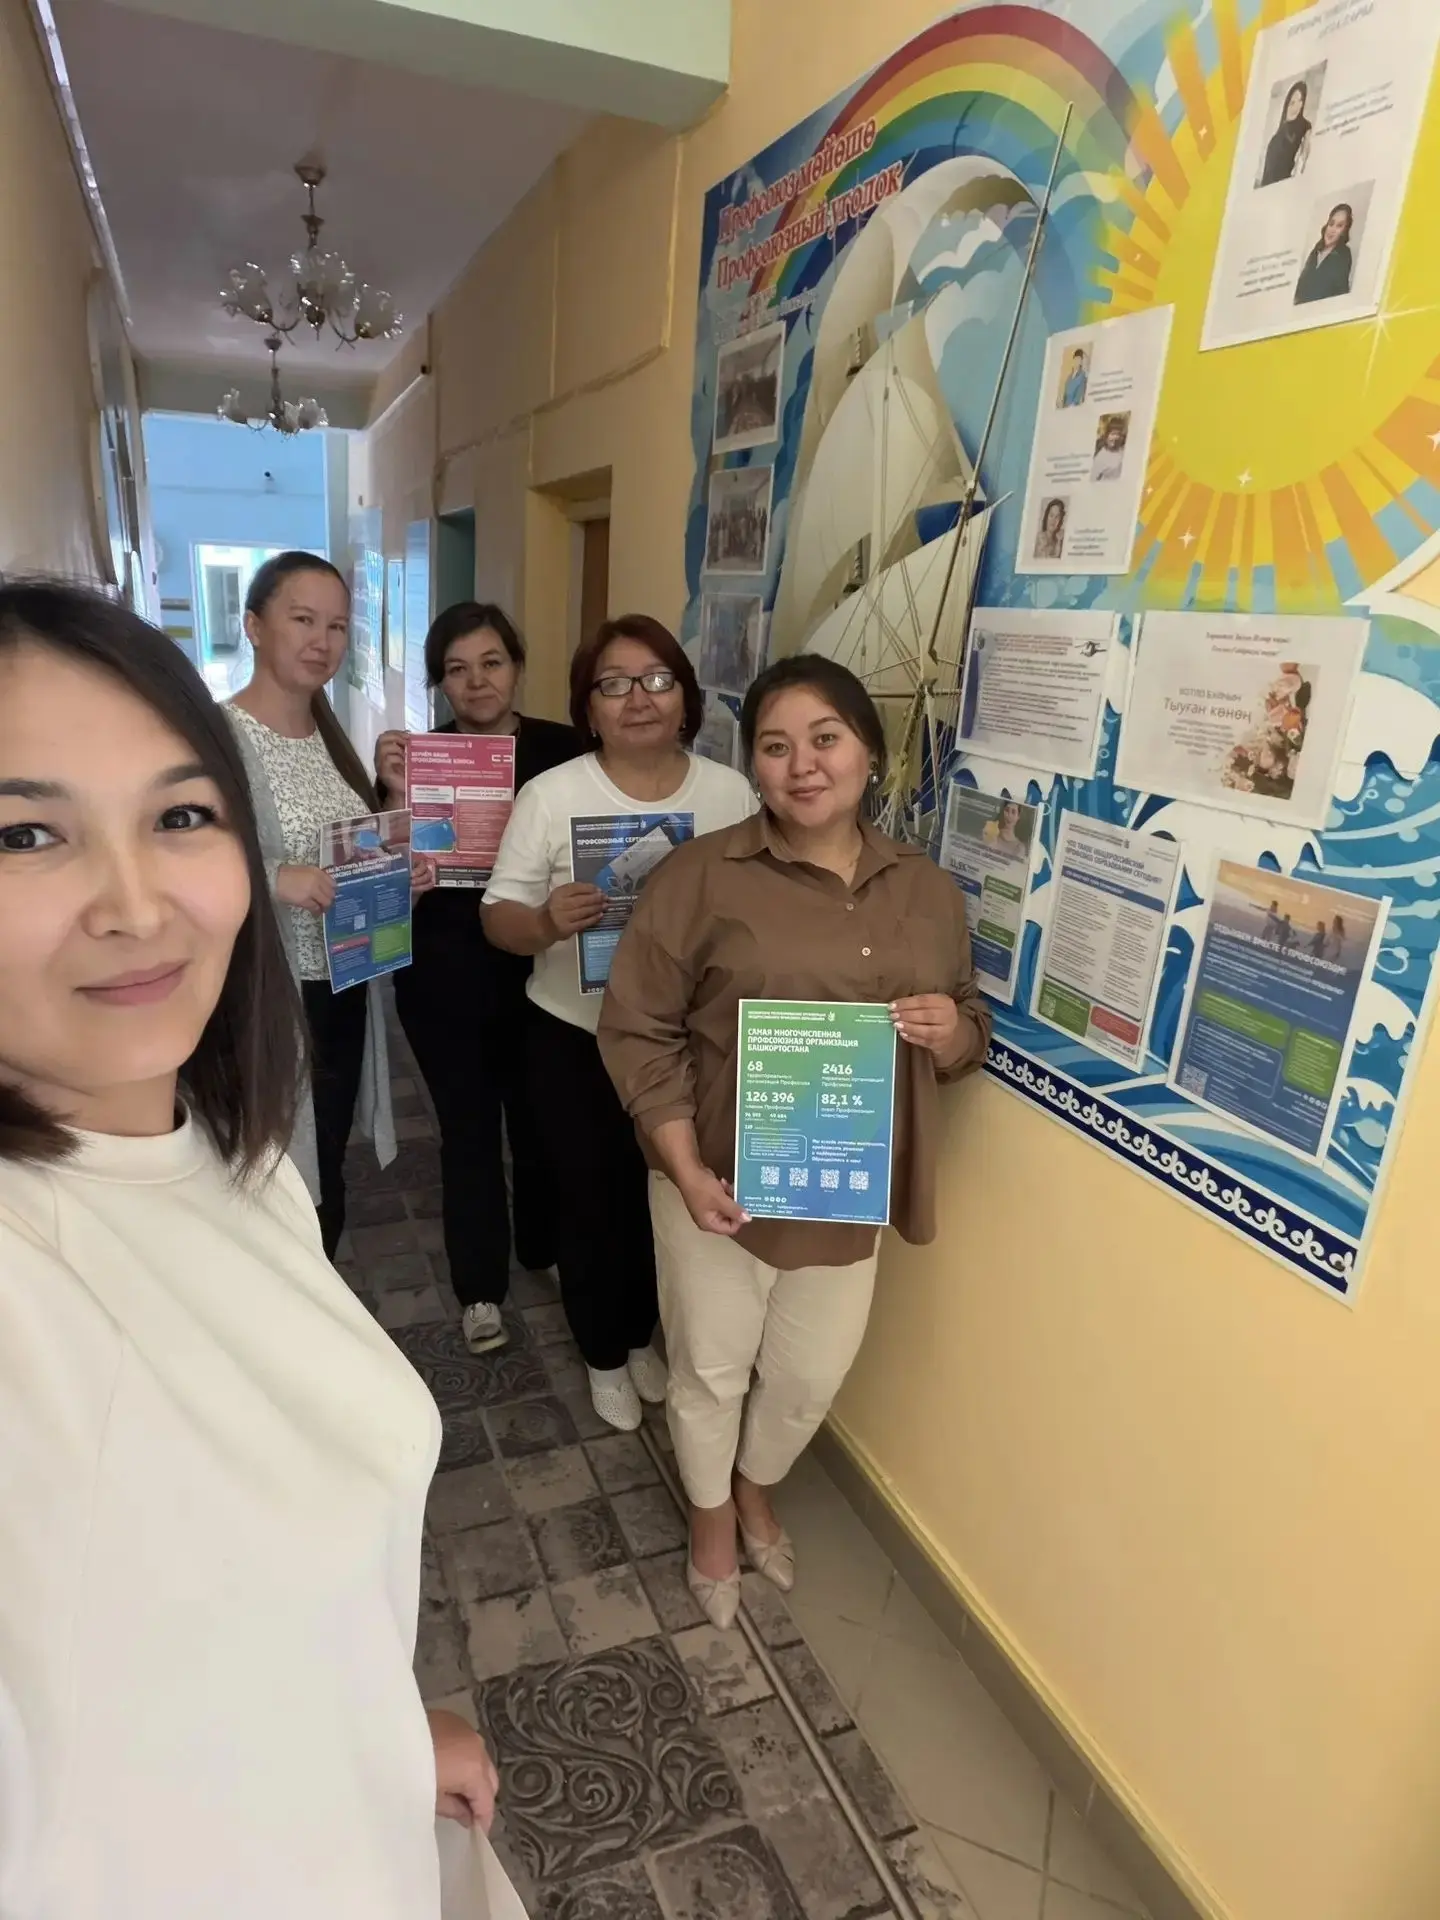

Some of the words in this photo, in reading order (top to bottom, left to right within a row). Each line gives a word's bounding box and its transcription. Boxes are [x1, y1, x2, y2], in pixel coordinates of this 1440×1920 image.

[718, 171, 797, 244] Профсоюз
[717, 197, 828, 290] Профсоюзный
[827, 160, 904, 240] уголок
[747, 1028, 772, 1036] САМАЯ
[774, 1029, 842, 1039] МНОГОЧИСЛЕННАЯ
[747, 1036, 804, 1045] ПРОФСОЮЗНАЯ
[805, 1038, 858, 1047] ОРГАНИЗАЦИЯ
[747, 1044, 809, 1053] БАШКОРТОСТАНА
[747, 1060, 764, 1072] 68
[822, 1063, 853, 1075] 2416
[745, 1091, 768, 1102] 126
[771, 1091, 795, 1103] 396
[821, 1093, 848, 1108] 82,1
[852, 1094, 863, 1106] %
